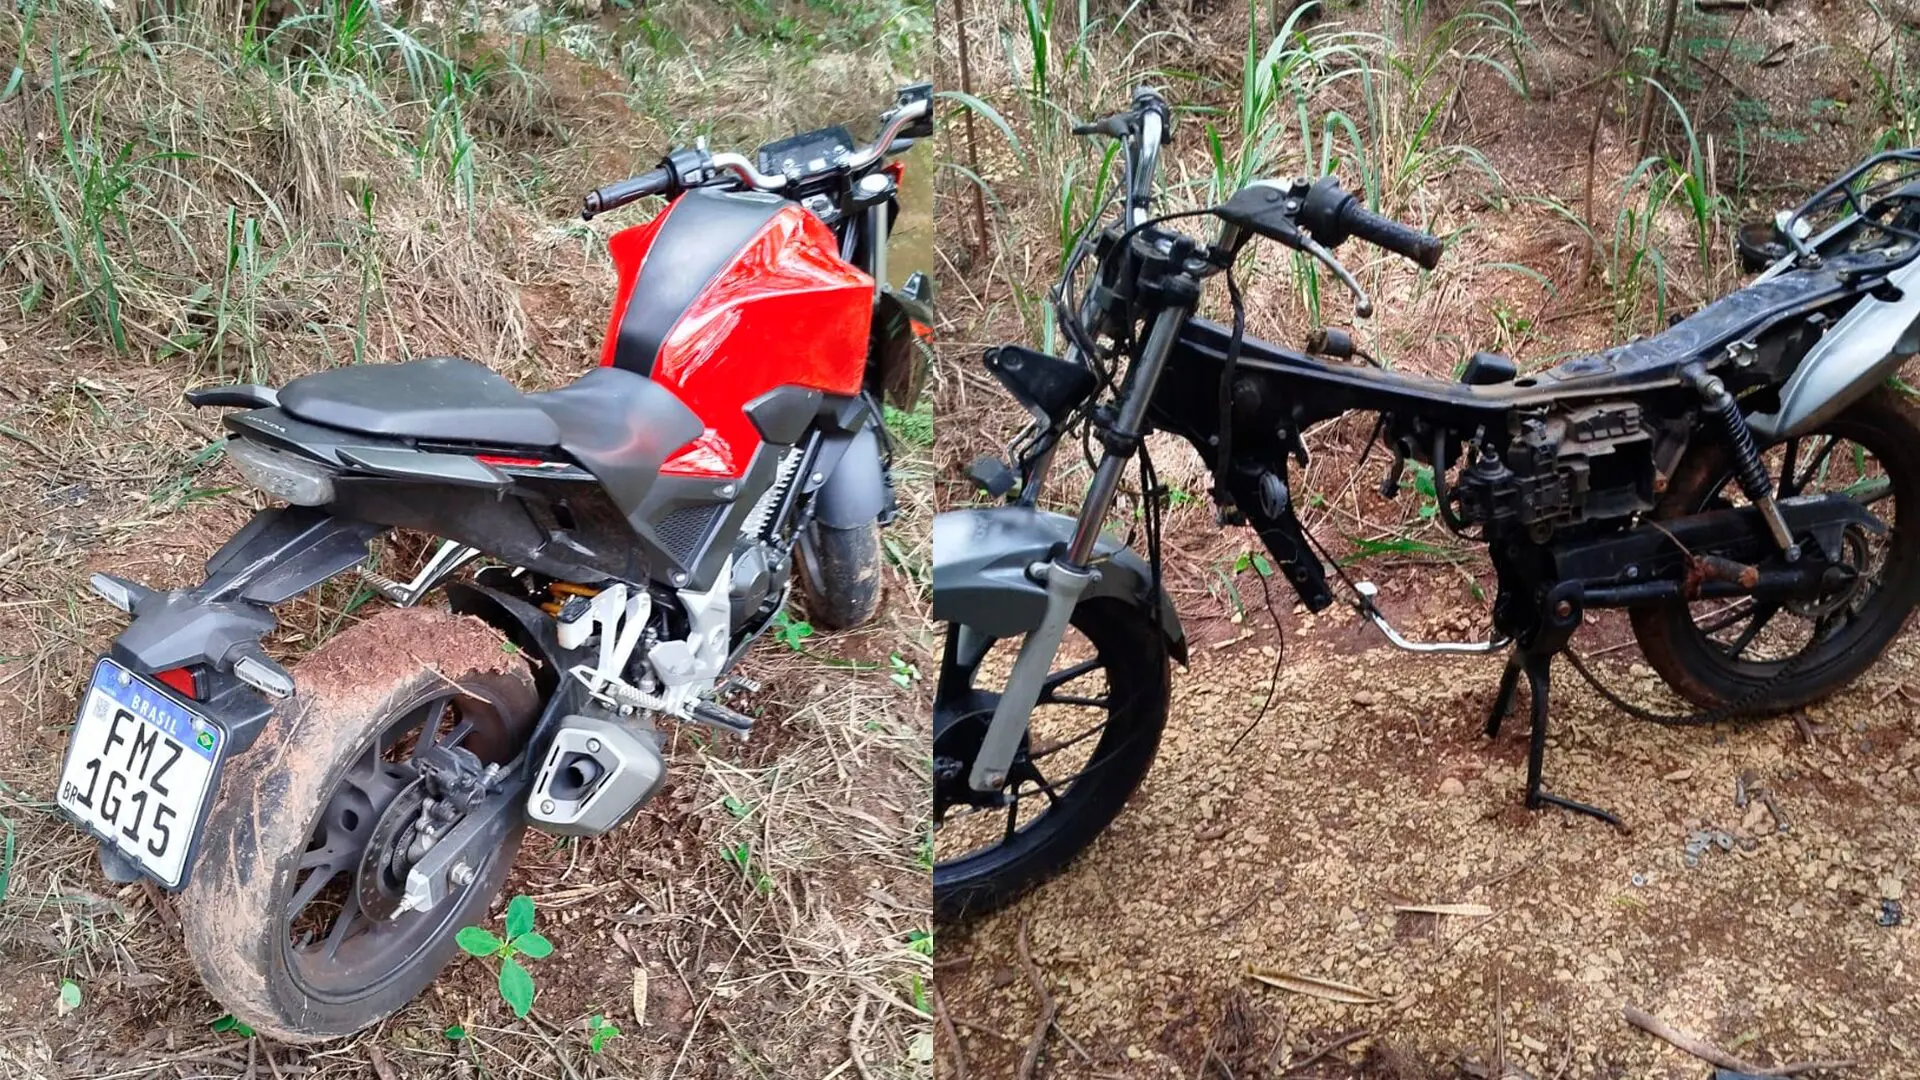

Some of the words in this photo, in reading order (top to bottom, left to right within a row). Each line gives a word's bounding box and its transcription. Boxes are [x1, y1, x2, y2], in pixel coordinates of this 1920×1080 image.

[131, 694, 177, 735] BRASIL
[103, 708, 184, 798] FMZ
[62, 780, 78, 805] BR
[76, 757, 177, 858] 1G15
